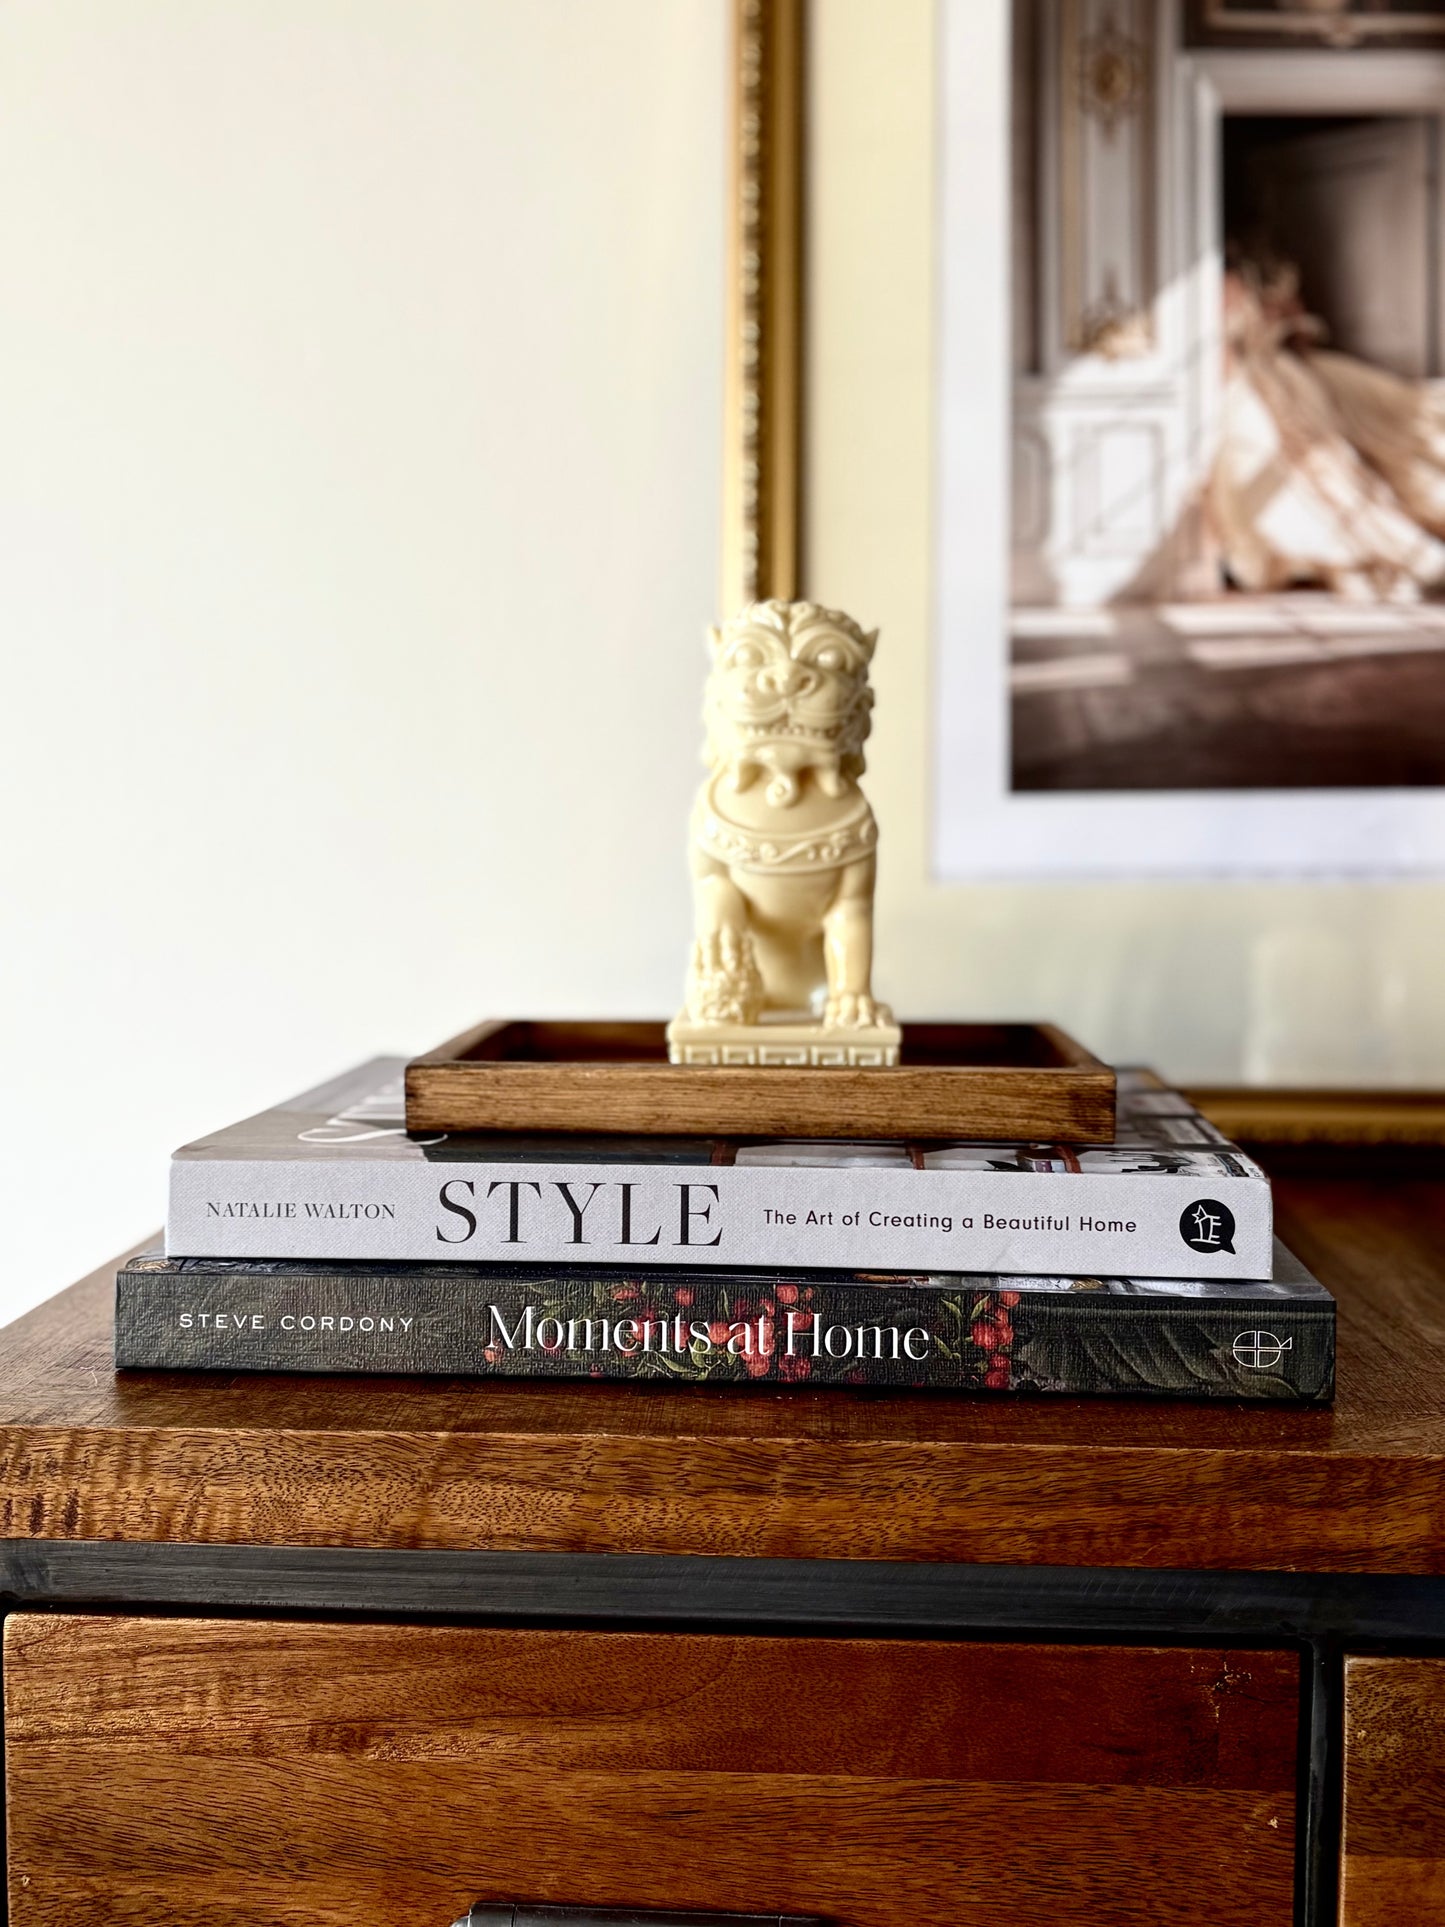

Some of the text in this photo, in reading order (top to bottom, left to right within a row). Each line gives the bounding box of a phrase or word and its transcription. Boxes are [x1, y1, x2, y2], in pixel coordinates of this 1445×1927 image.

[206, 1202, 396, 1220] NATALIE WALTON
[436, 1179, 723, 1247] STYLE
[763, 1209, 1137, 1233] The Art of Creating a Beautiful Home
[179, 1313, 414, 1333] STEVE CORDONY
[487, 1304, 929, 1361] Moments at Home
